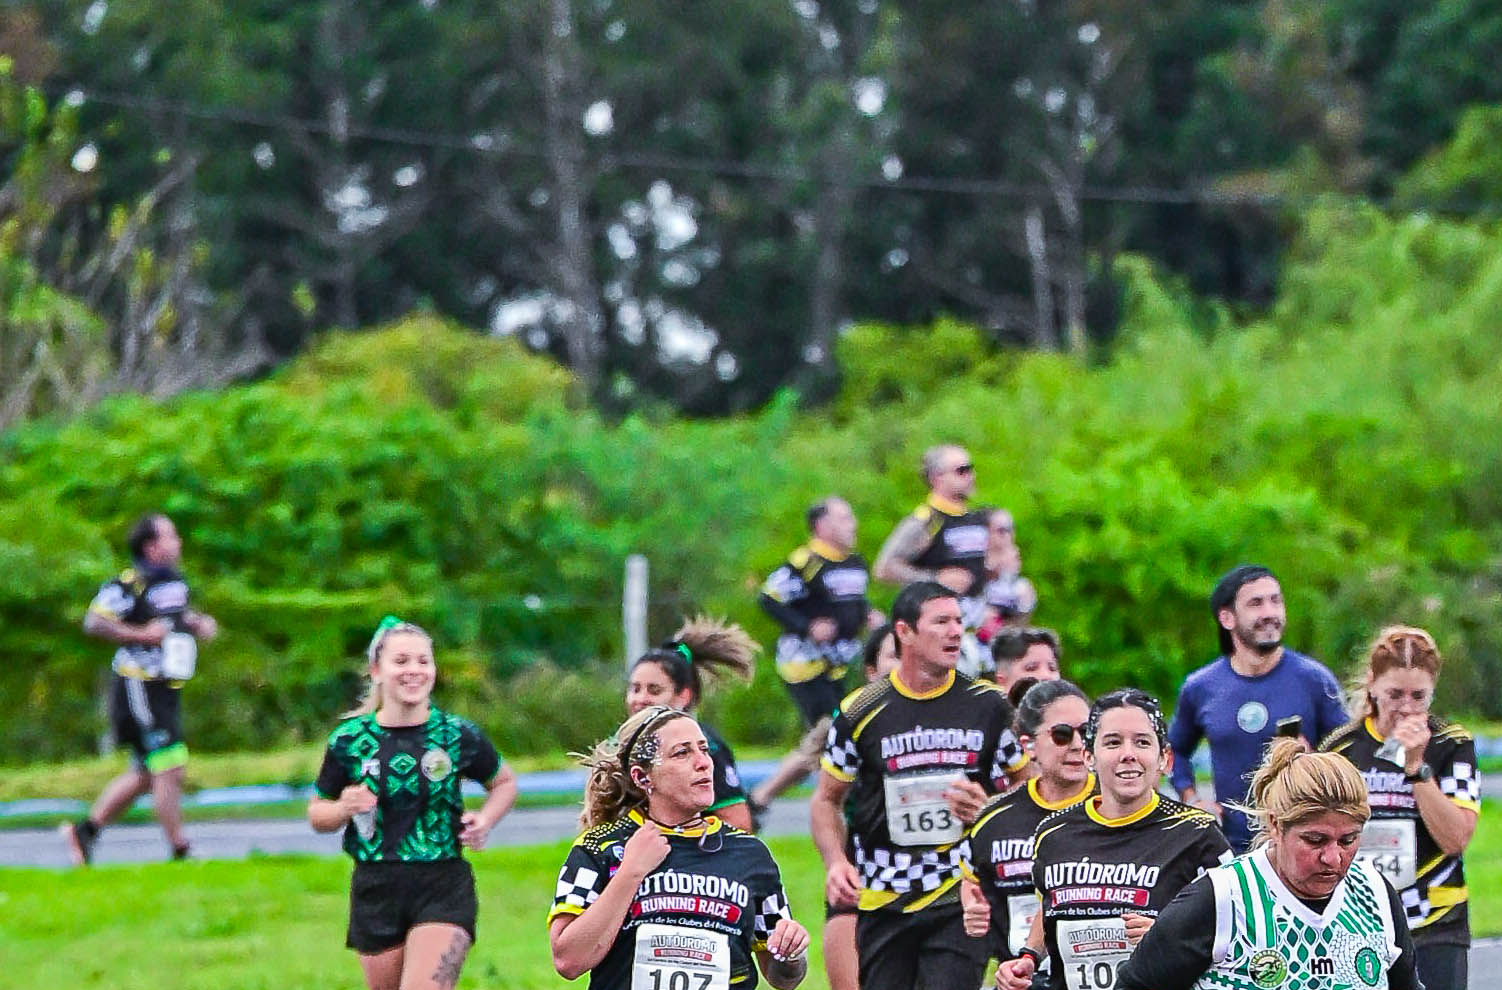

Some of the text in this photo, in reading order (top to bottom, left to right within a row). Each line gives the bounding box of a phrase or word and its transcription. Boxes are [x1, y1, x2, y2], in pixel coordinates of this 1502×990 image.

[902, 809, 952, 833] 163
[1045, 857, 1160, 889] AUTÓDROMO
[635, 868, 749, 908] UTÓDROMO
[1055, 888, 1136, 904] RUNNING RACE
[641, 896, 731, 919] RUNNING RACE
[1077, 962, 1114, 990] 10
